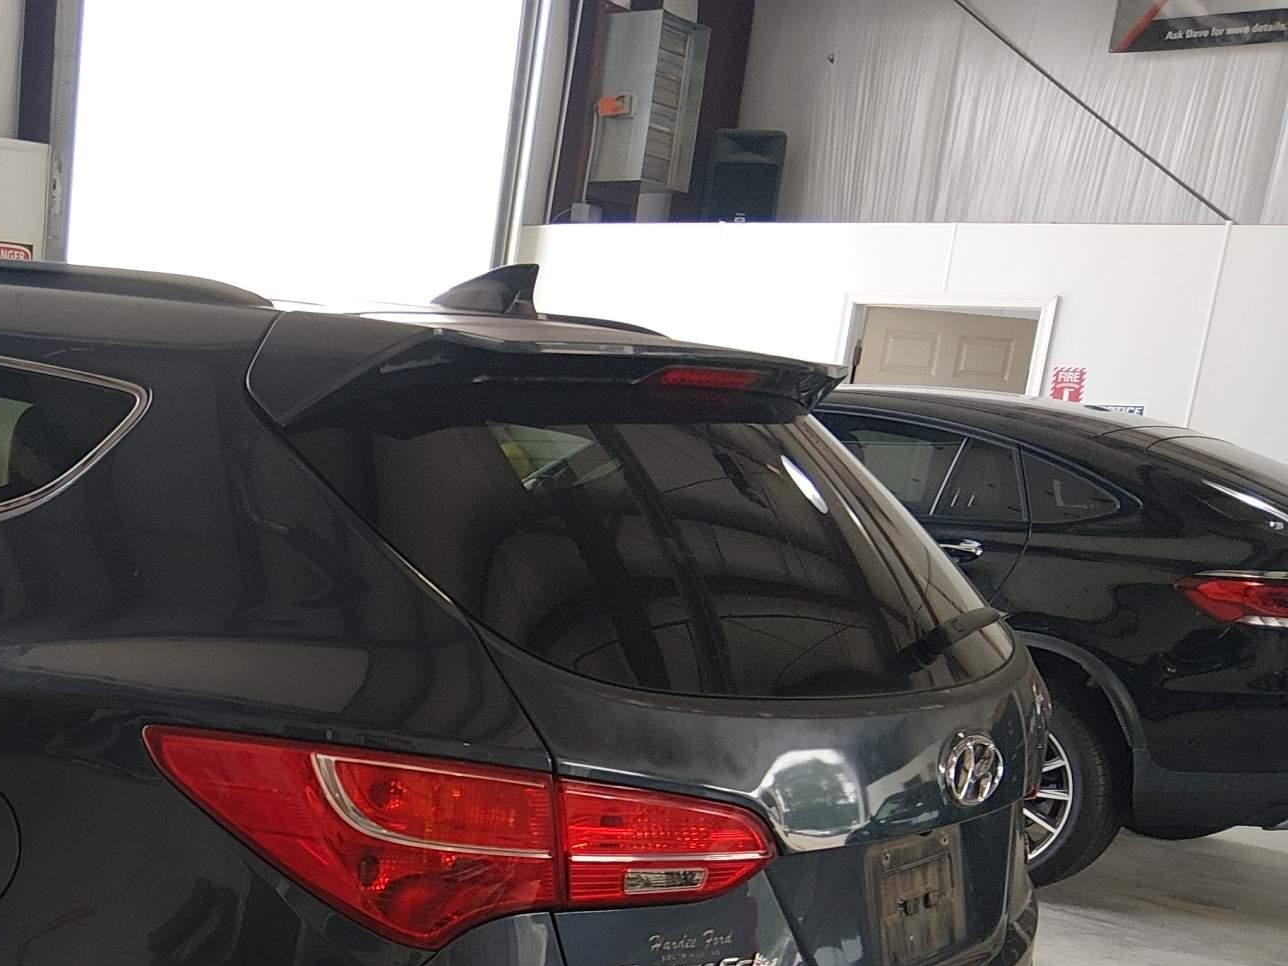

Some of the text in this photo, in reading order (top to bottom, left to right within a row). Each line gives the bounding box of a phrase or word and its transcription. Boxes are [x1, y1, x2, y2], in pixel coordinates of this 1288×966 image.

[1165, 30, 1184, 40] Ask
[1185, 29, 1209, 39] Dave
[1211, 27, 1225, 37] for
[1058, 371, 1081, 383] FIRE
[703, 929, 733, 948] Ford
